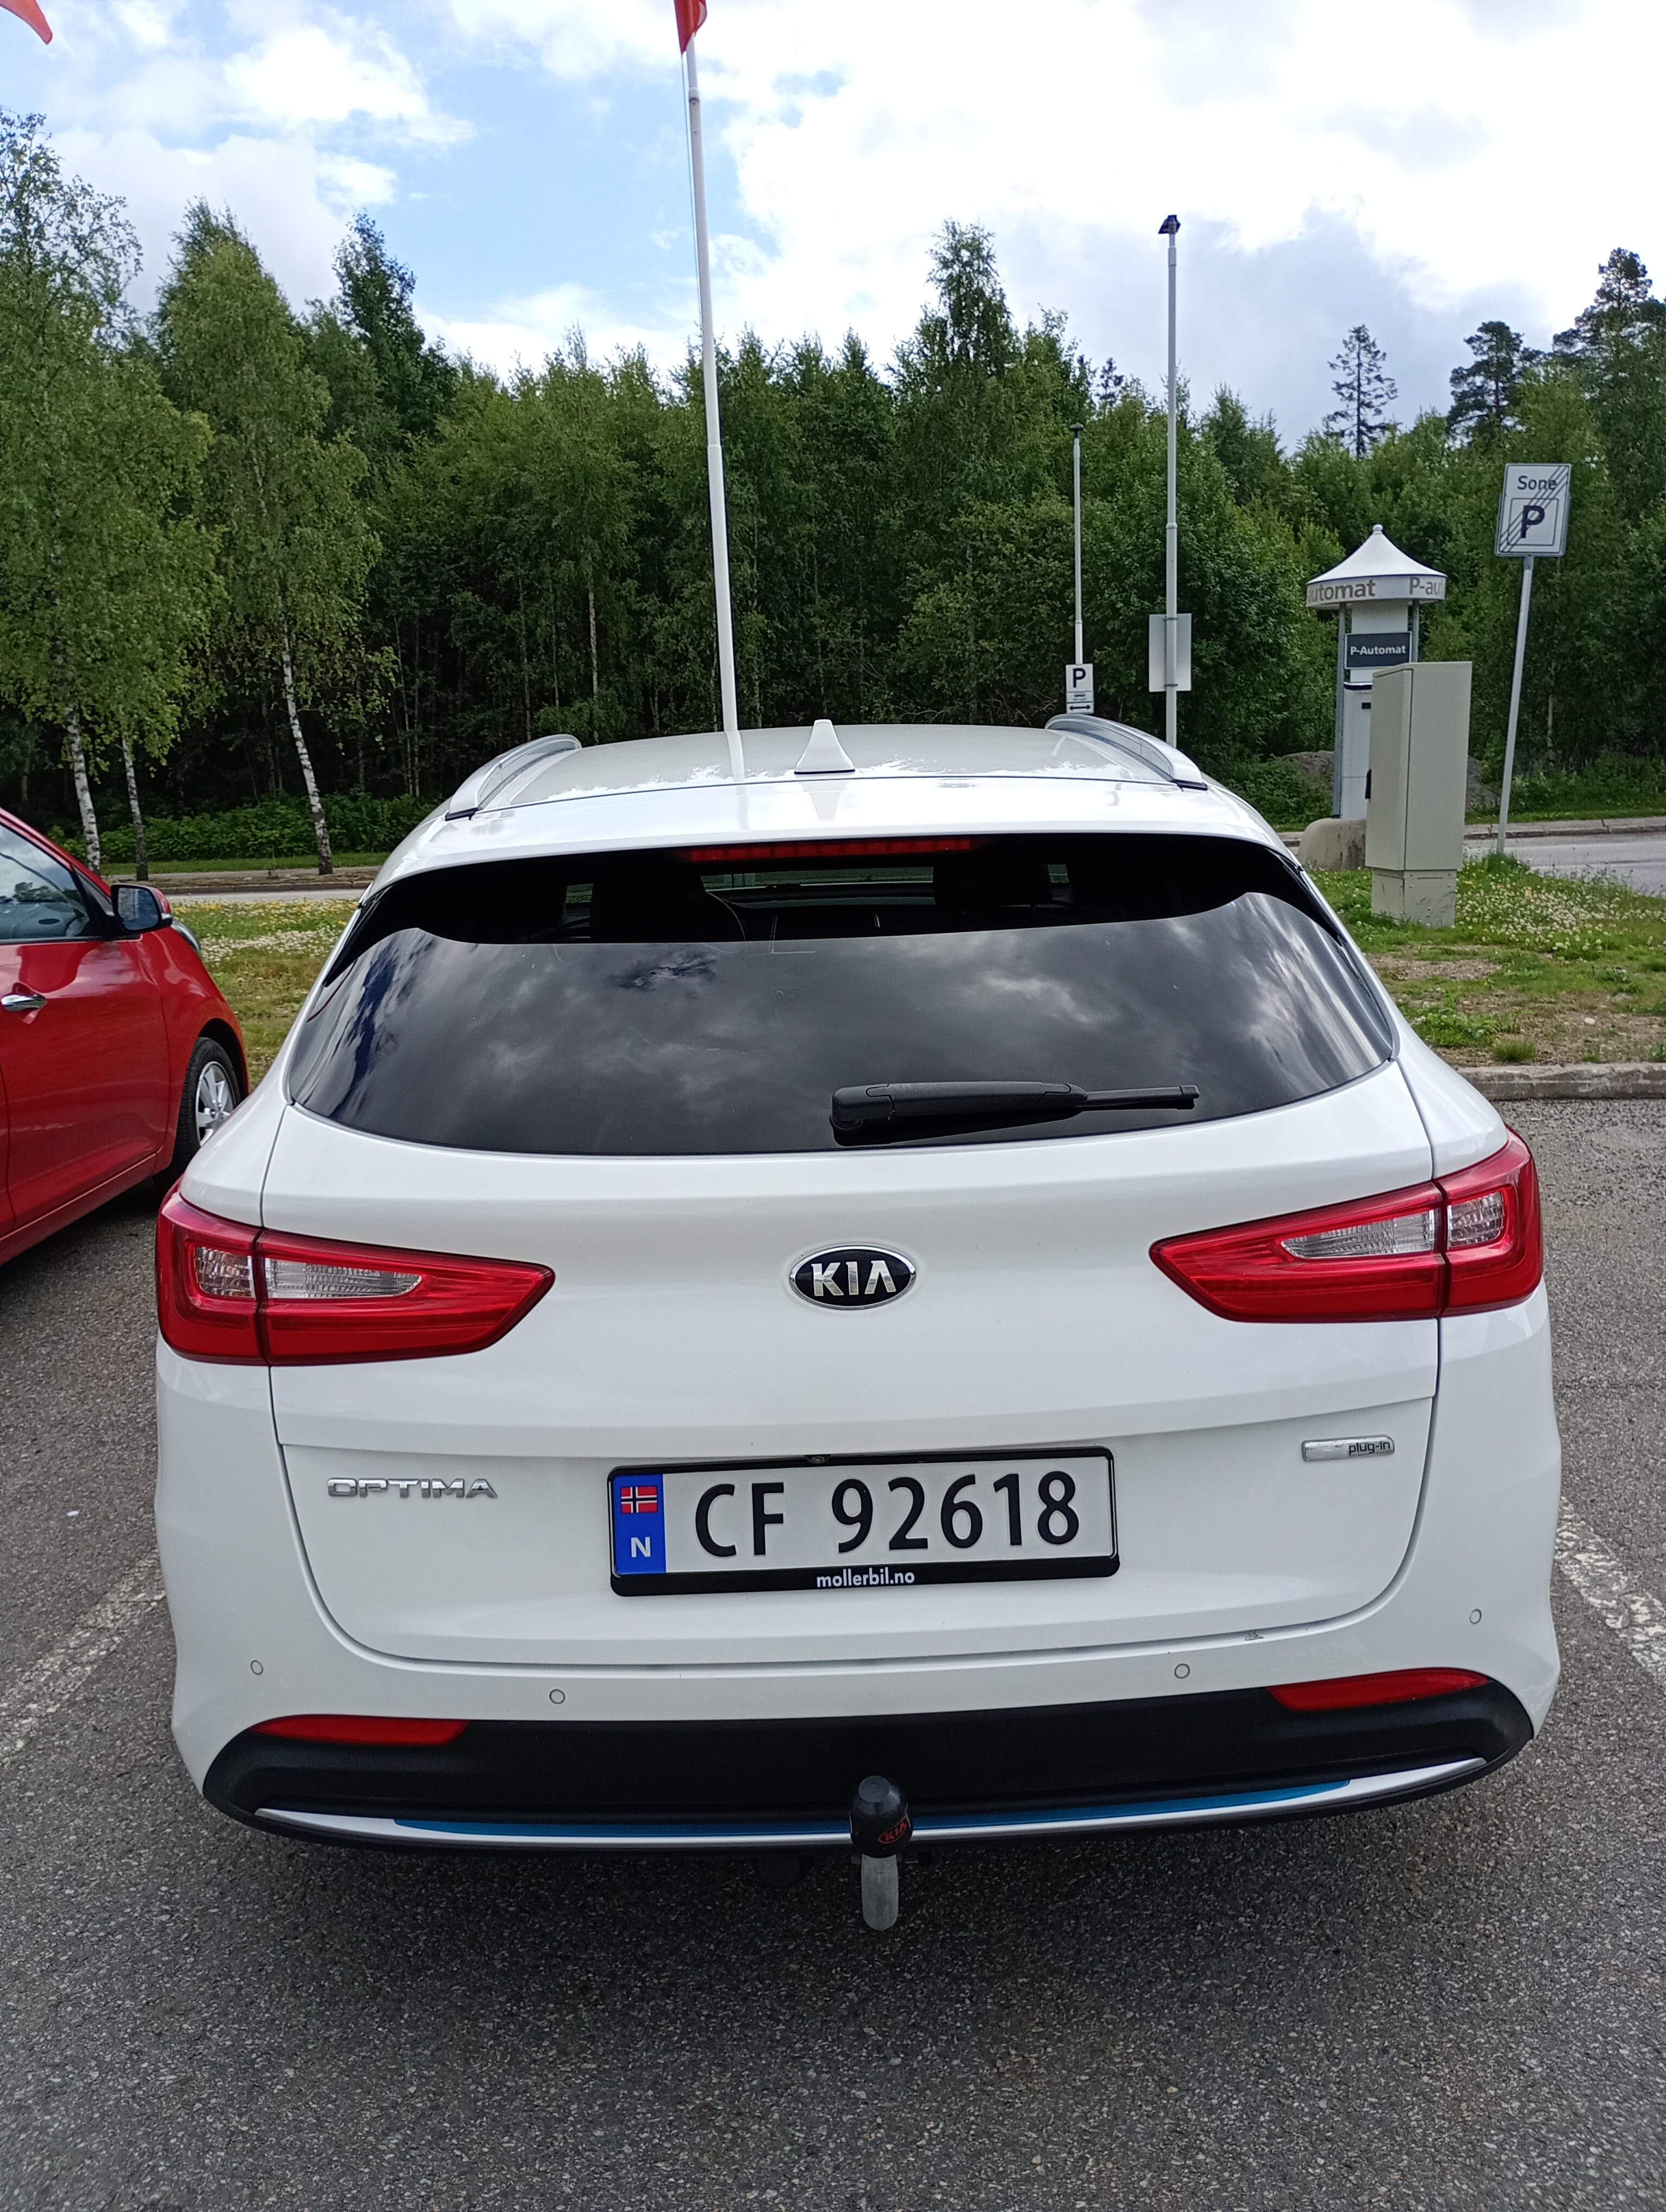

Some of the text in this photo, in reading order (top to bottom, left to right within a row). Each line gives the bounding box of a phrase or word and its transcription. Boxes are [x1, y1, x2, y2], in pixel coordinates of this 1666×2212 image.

[1517, 475, 1557, 490] Sone
[1521, 505, 1545, 538] P
[1350, 645, 1406, 655] P-Automat
[1073, 668, 1086, 688] P
[811, 1260, 896, 1296] KIA
[1348, 1440, 1391, 1456] plug-in
[326, 1477, 498, 1498] OPTIMA
[695, 1470, 1079, 1557] CF 92618
[631, 1536, 651, 1558] N
[816, 1566, 915, 1588] mollerbil.no
